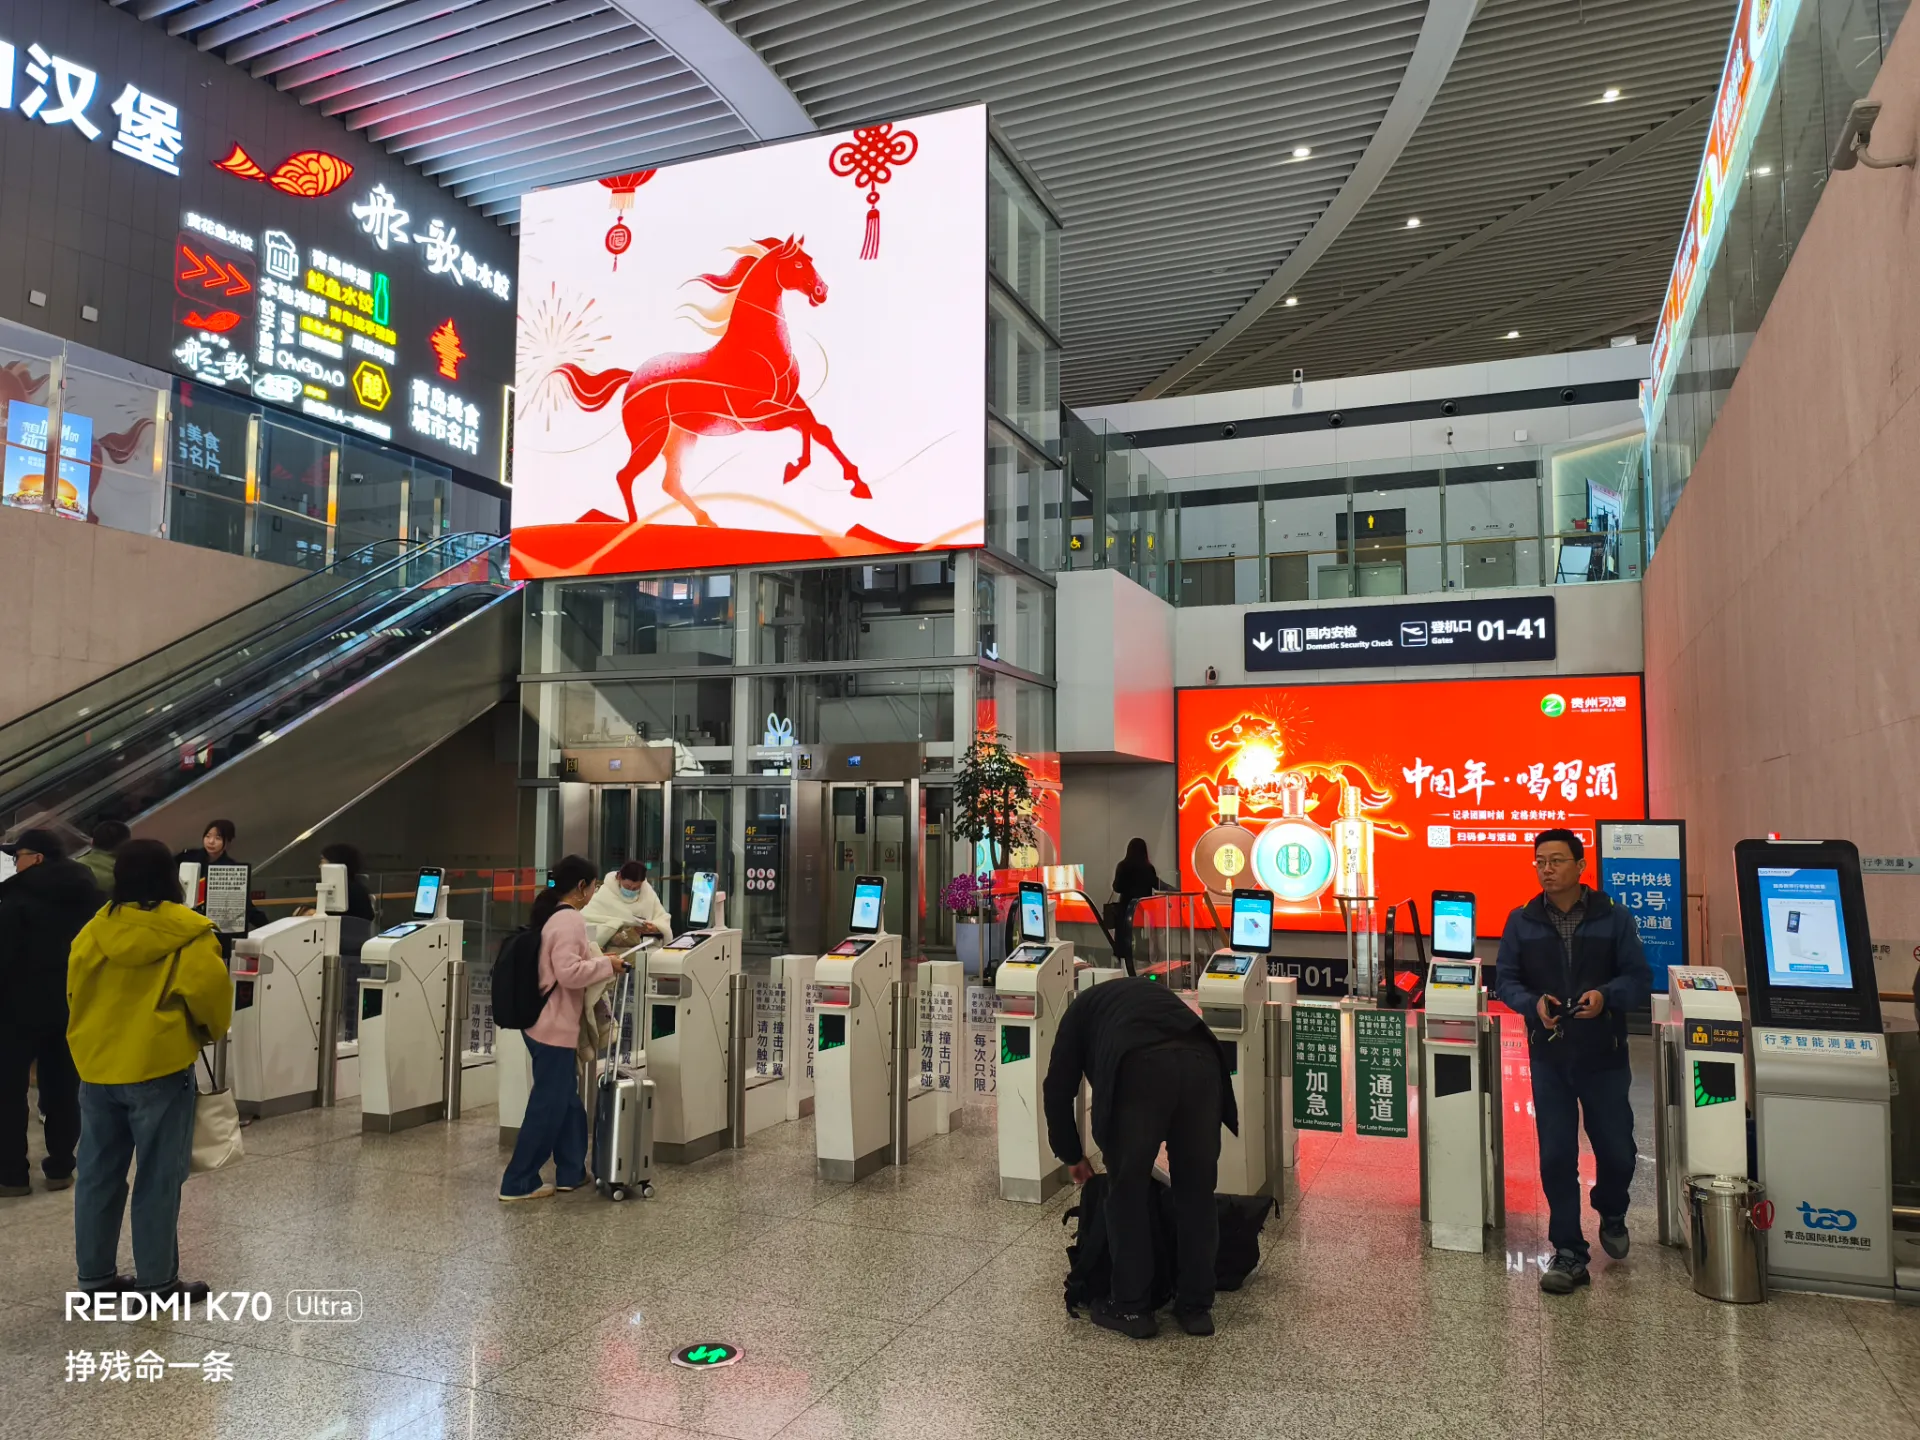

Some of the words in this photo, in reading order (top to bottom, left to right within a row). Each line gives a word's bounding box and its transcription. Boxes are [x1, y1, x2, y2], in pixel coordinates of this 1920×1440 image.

[0, 40, 183, 176] 汉堡
[411, 378, 480, 430] 青岛美食
[411, 404, 479, 456] 城市名片
[1305, 625, 1357, 640] 国内安检
[1431, 620, 1472, 634] 登机口
[1477, 617, 1546, 642] 01-41
[1306, 641, 1339, 650] Domestic
[1340, 640, 1370, 650] Security
[1371, 638, 1393, 648] Check
[1431, 636, 1453, 644] Gates
[1571, 696, 1627, 709] 贵州习酒
[1452, 810, 1505, 821] 记录团圆时刻
[1510, 809, 1566, 821] 定格美好时光
[685, 826, 696, 835] 4F
[746, 827, 757, 835] 4F
[1456, 831, 1517, 843] 扫码参与活动
[1863, 858, 1905, 867] 行李测量
[1611, 872, 1672, 888] 空中快线
[1619, 890, 1666, 911] 13号
[470, 1003, 480, 1053] 请勿触碰
[1295, 1025, 1337, 1033] 请走人工验证
[1358, 1029, 1402, 1037] 请走人工验证
[1713, 1028, 1739, 1037] 员工通道
[757, 1020, 768, 1075] 请勿触碰
[773, 1021, 784, 1076] 撞击门翼
[1296, 1041, 1337, 1053] 请勿触碰
[1764, 1034, 1873, 1051] 行李智能测量机
[1296, 1052, 1337, 1063] 撞击门翼
[1359, 1046, 1402, 1057] 每次只限
[921, 1030, 933, 1088] 请勿触碰
[939, 1031, 951, 1089] 撞击门翼
[974, 1034, 986, 1092] 每次只限
[1359, 1056, 1403, 1067] 一人进入
[1305, 1068, 1329, 1116] 加急
[1369, 1074, 1394, 1122] 通道
[1314, 1119, 1341, 1128] Passengers
[1378, 1125, 1406, 1133] Passengers
[1795, 1200, 1857, 1232] tao
[1784, 1230, 1871, 1247] 青岛国际机场集团
